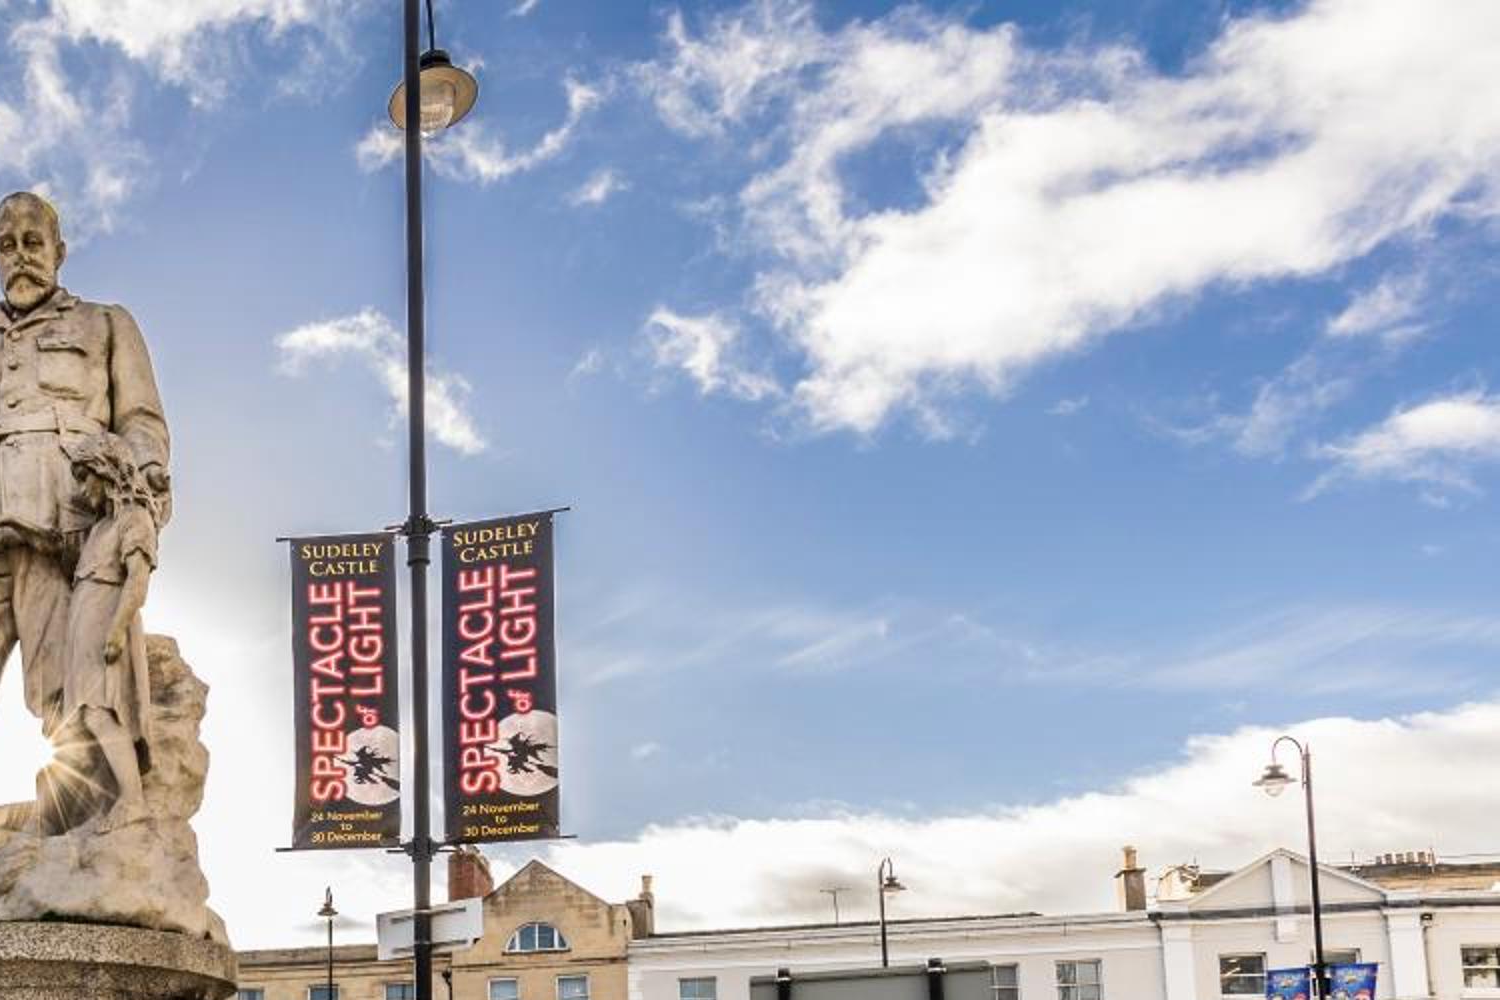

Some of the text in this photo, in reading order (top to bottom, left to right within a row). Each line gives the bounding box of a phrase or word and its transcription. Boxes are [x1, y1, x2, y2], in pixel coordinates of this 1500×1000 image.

[453, 521, 539, 547] SUDELEY
[301, 543, 383, 559] SUDELEY
[460, 540, 533, 562] CASTLE
[309, 560, 380, 576] CASTLE
[500, 565, 536, 712] of LIGHT
[347, 581, 383, 727] of LIGHT
[459, 566, 497, 793] SPECTACLE
[309, 582, 345, 801] SPECTACLE
[327, 810, 383, 821] November
[463, 801, 540, 816] 24 November
[341, 823, 352, 831] to
[495, 816, 507, 824] to
[327, 831, 382, 842] December
[481, 823, 540, 836] December
